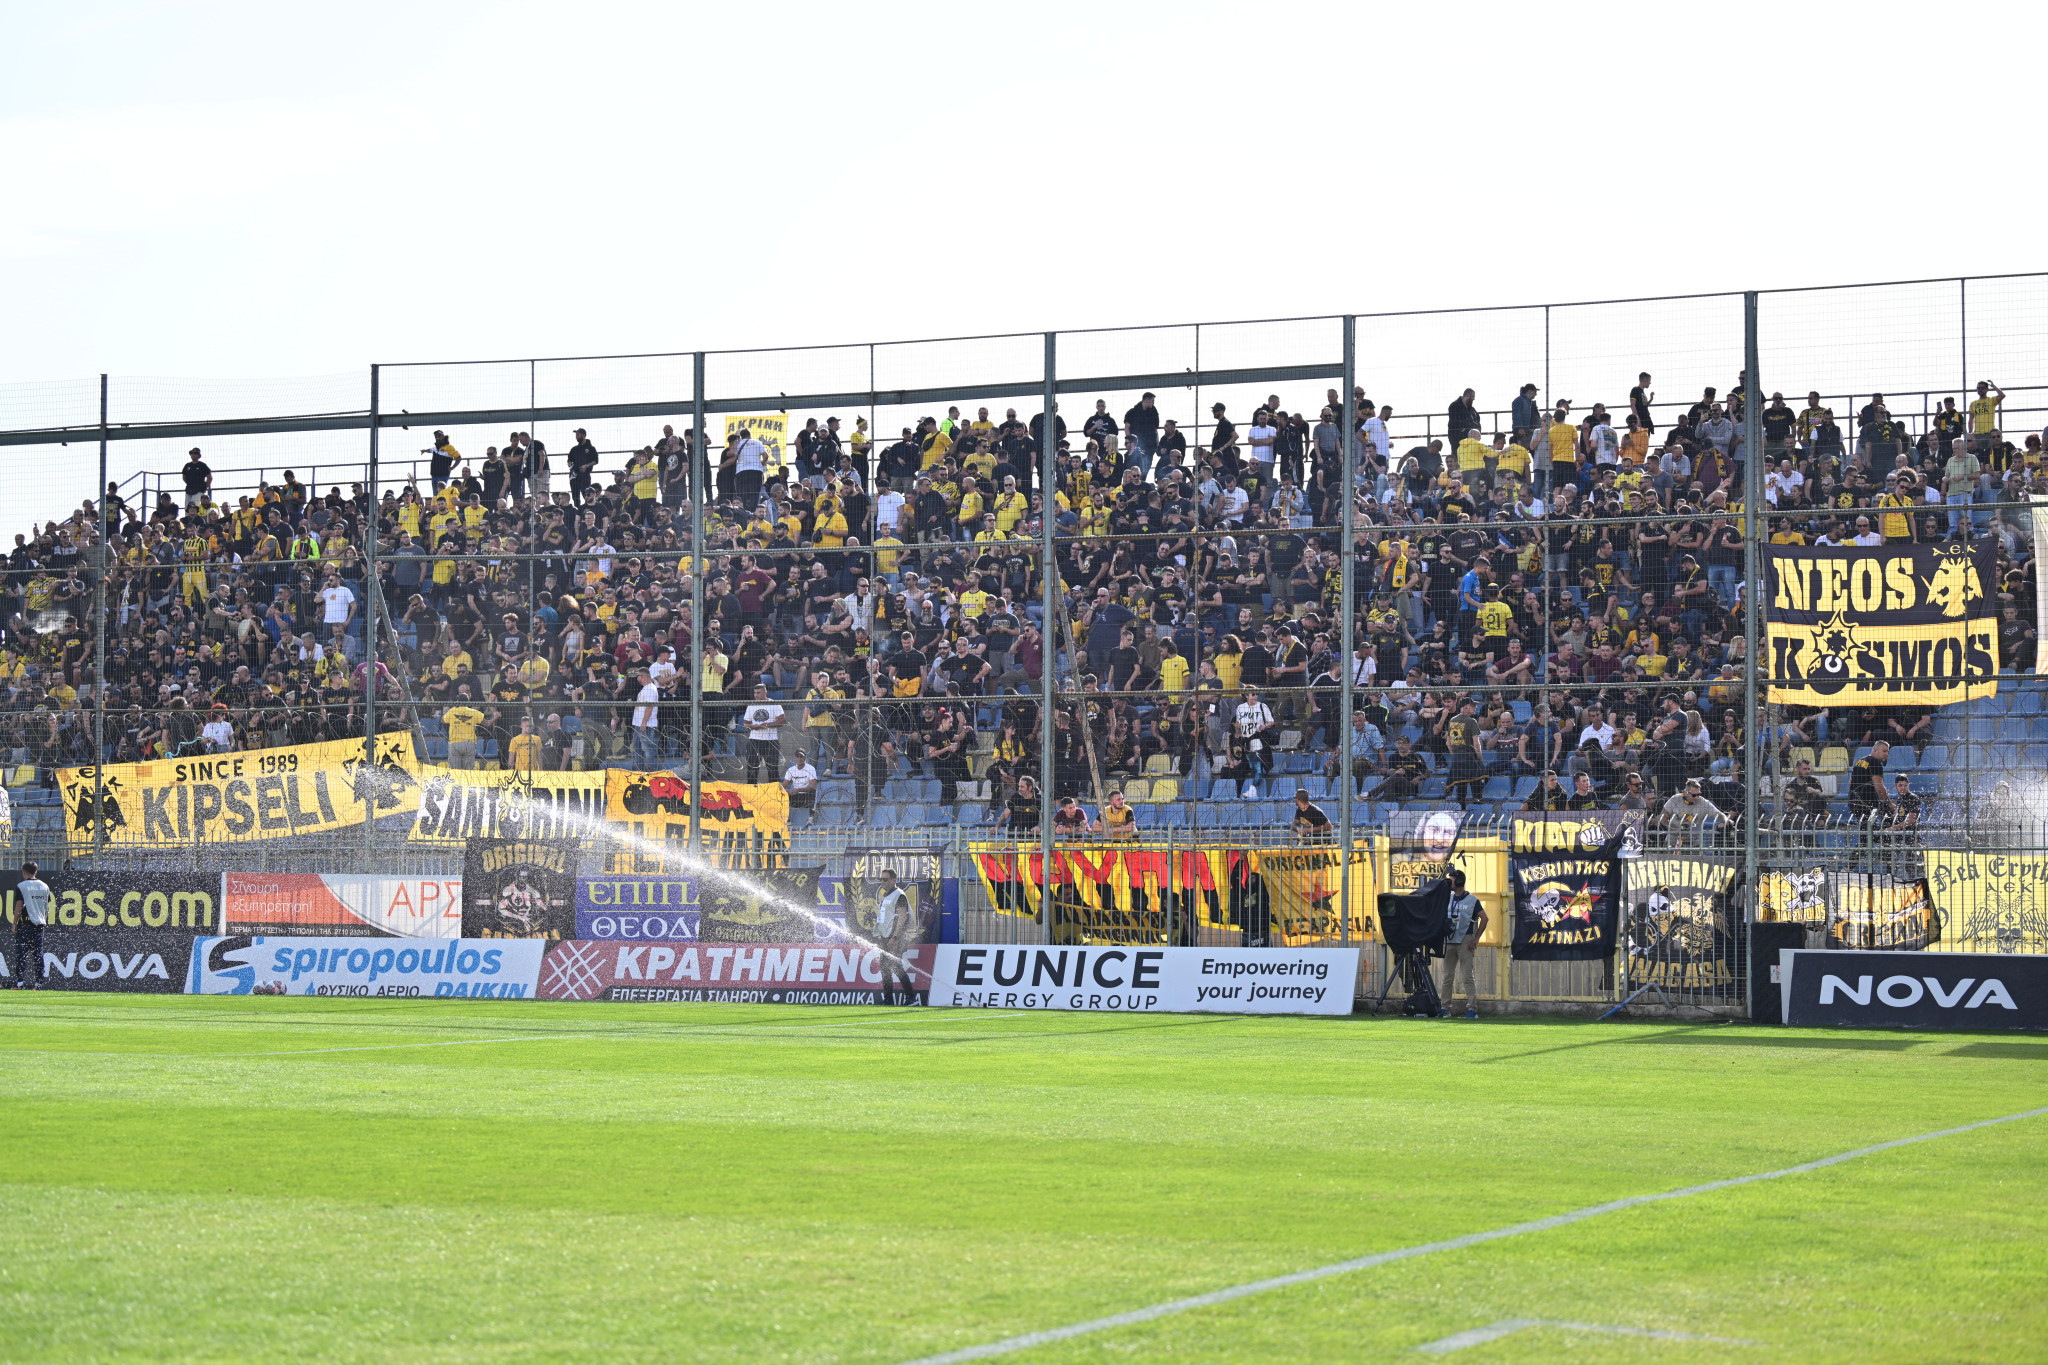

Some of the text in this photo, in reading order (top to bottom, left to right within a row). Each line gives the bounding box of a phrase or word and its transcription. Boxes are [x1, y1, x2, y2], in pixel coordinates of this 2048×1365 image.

[1772, 556, 1916, 613] NEOS
[1486, 613, 1500, 630] 21
[176, 753, 298, 782] SINCE 1989
[142, 770, 338, 840] KIPSELI
[1264, 852, 1342, 873] ORIGINAL
[590, 916, 699, 938] ΘΕΟΔ
[1528, 925, 1602, 945] ANTINAZI
[43, 952, 170, 980] NOVA
[271, 938, 503, 983] spiropoulos
[956, 949, 1165, 989] EUNICE
[1201, 958, 1329, 979] Empowering
[317, 985, 420, 997] ΦΥΣΙΚΟ ΑΕΡΙΟ
[433, 981, 529, 999] DAIKIN
[611, 988, 702, 1002] ΕΠΕΞΕΡΓΑΣΙΑ
[707, 990, 768, 1004] ΣΙΔΗΡΟΥ
[785, 991, 874, 1005] ΟΙΚΟΔΟΜΙΚΑ
[1197, 984, 1327, 1003] your journey
[1819, 974, 2019, 1010] NOVA
[952, 992, 1159, 1010] ENERGY GROUP
